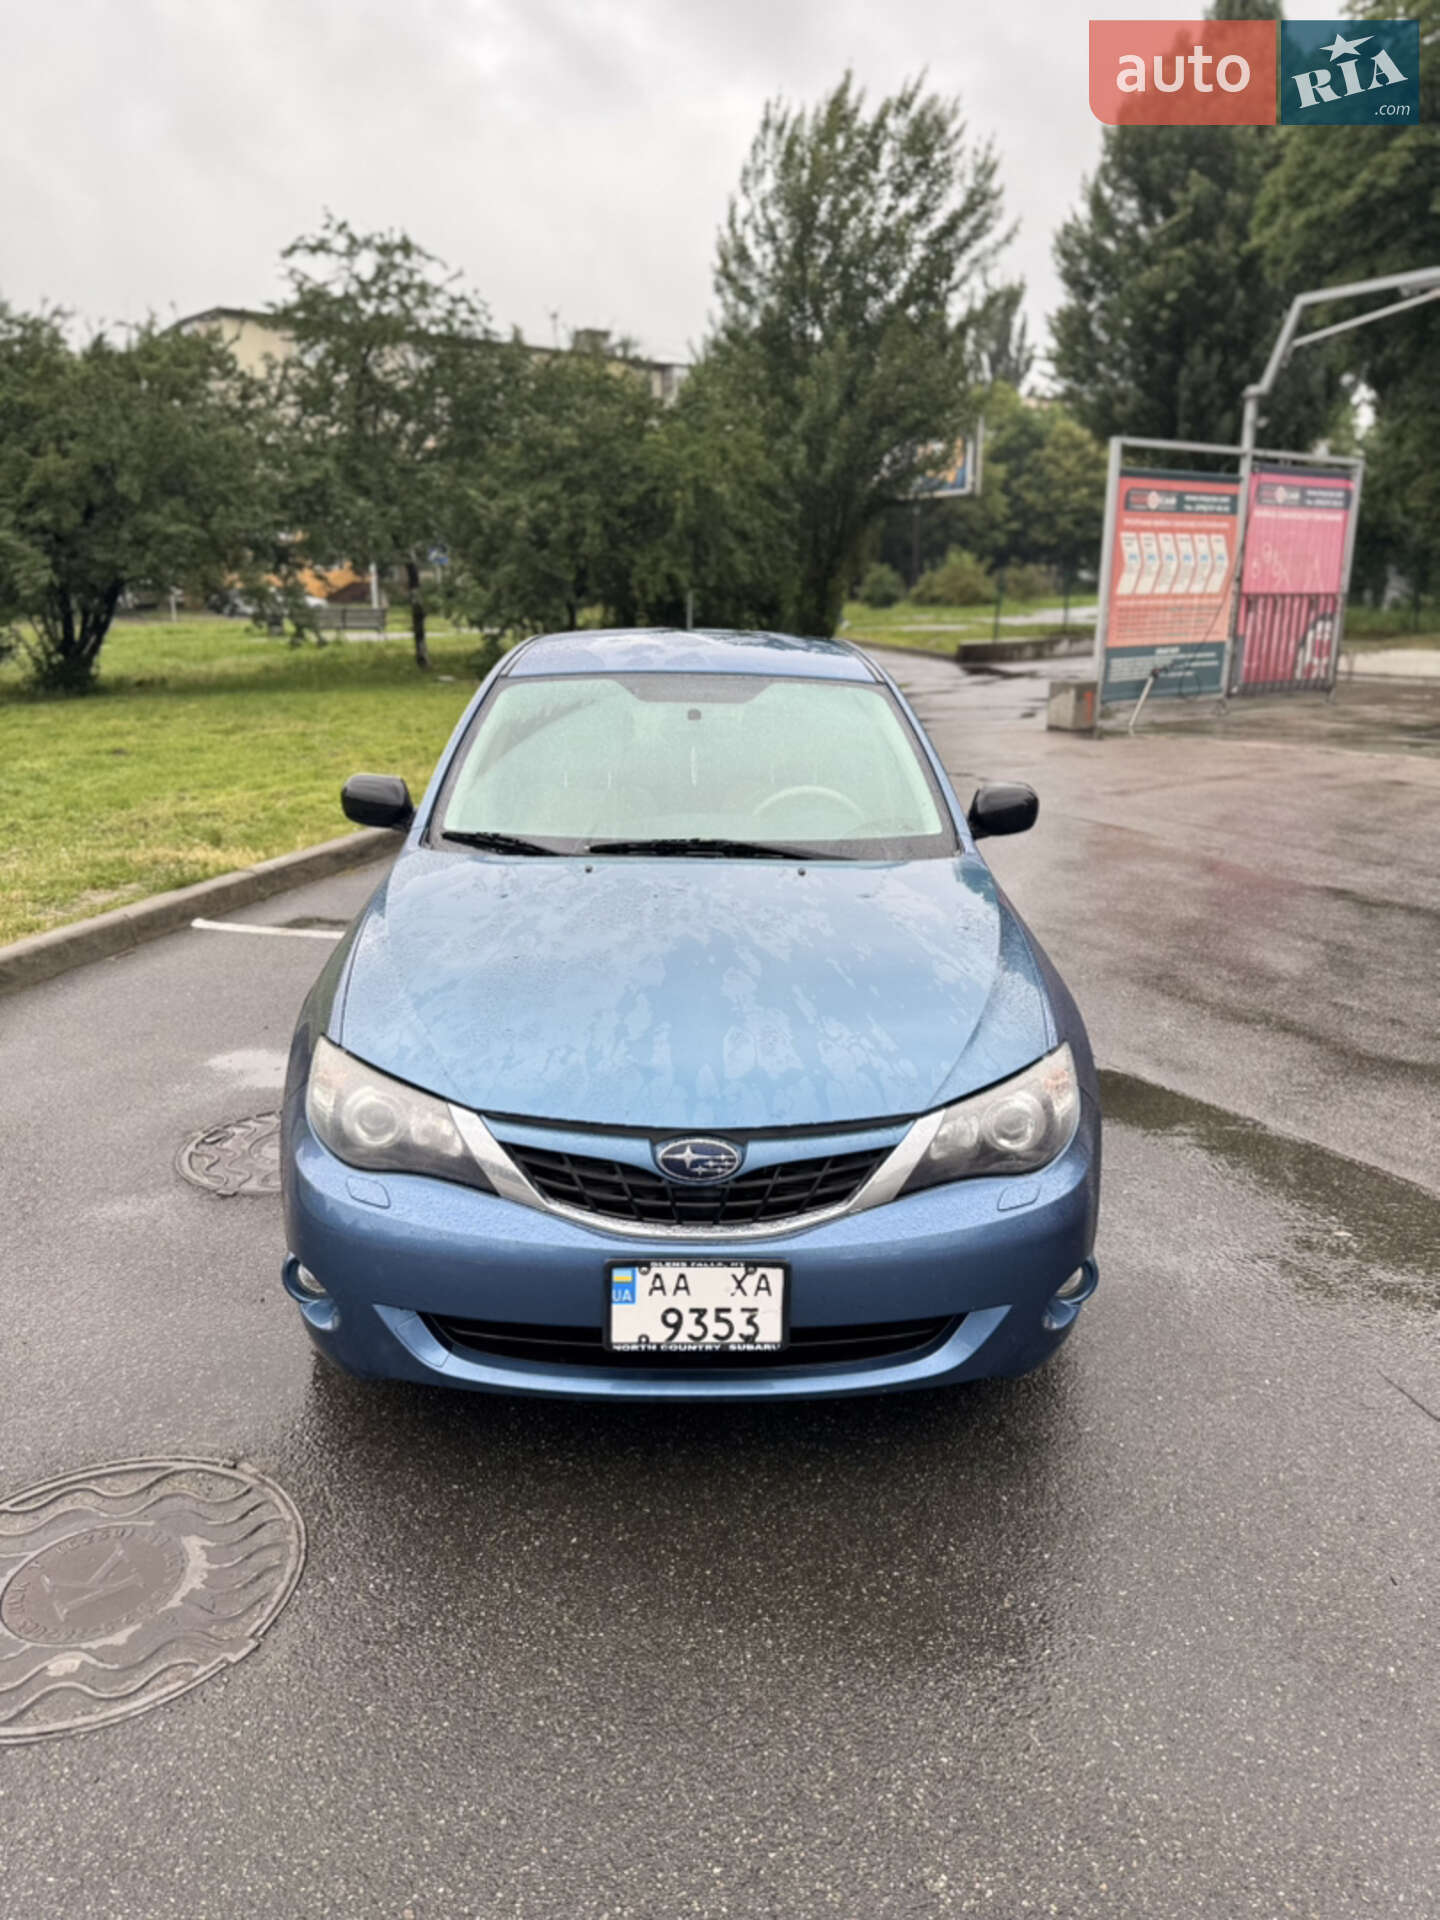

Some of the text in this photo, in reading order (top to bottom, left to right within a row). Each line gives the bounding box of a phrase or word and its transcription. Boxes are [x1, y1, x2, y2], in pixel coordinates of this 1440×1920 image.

[611, 1288, 633, 1303] UA
[648, 1272, 773, 1297] AA XA
[660, 1307, 760, 1342] 9353
